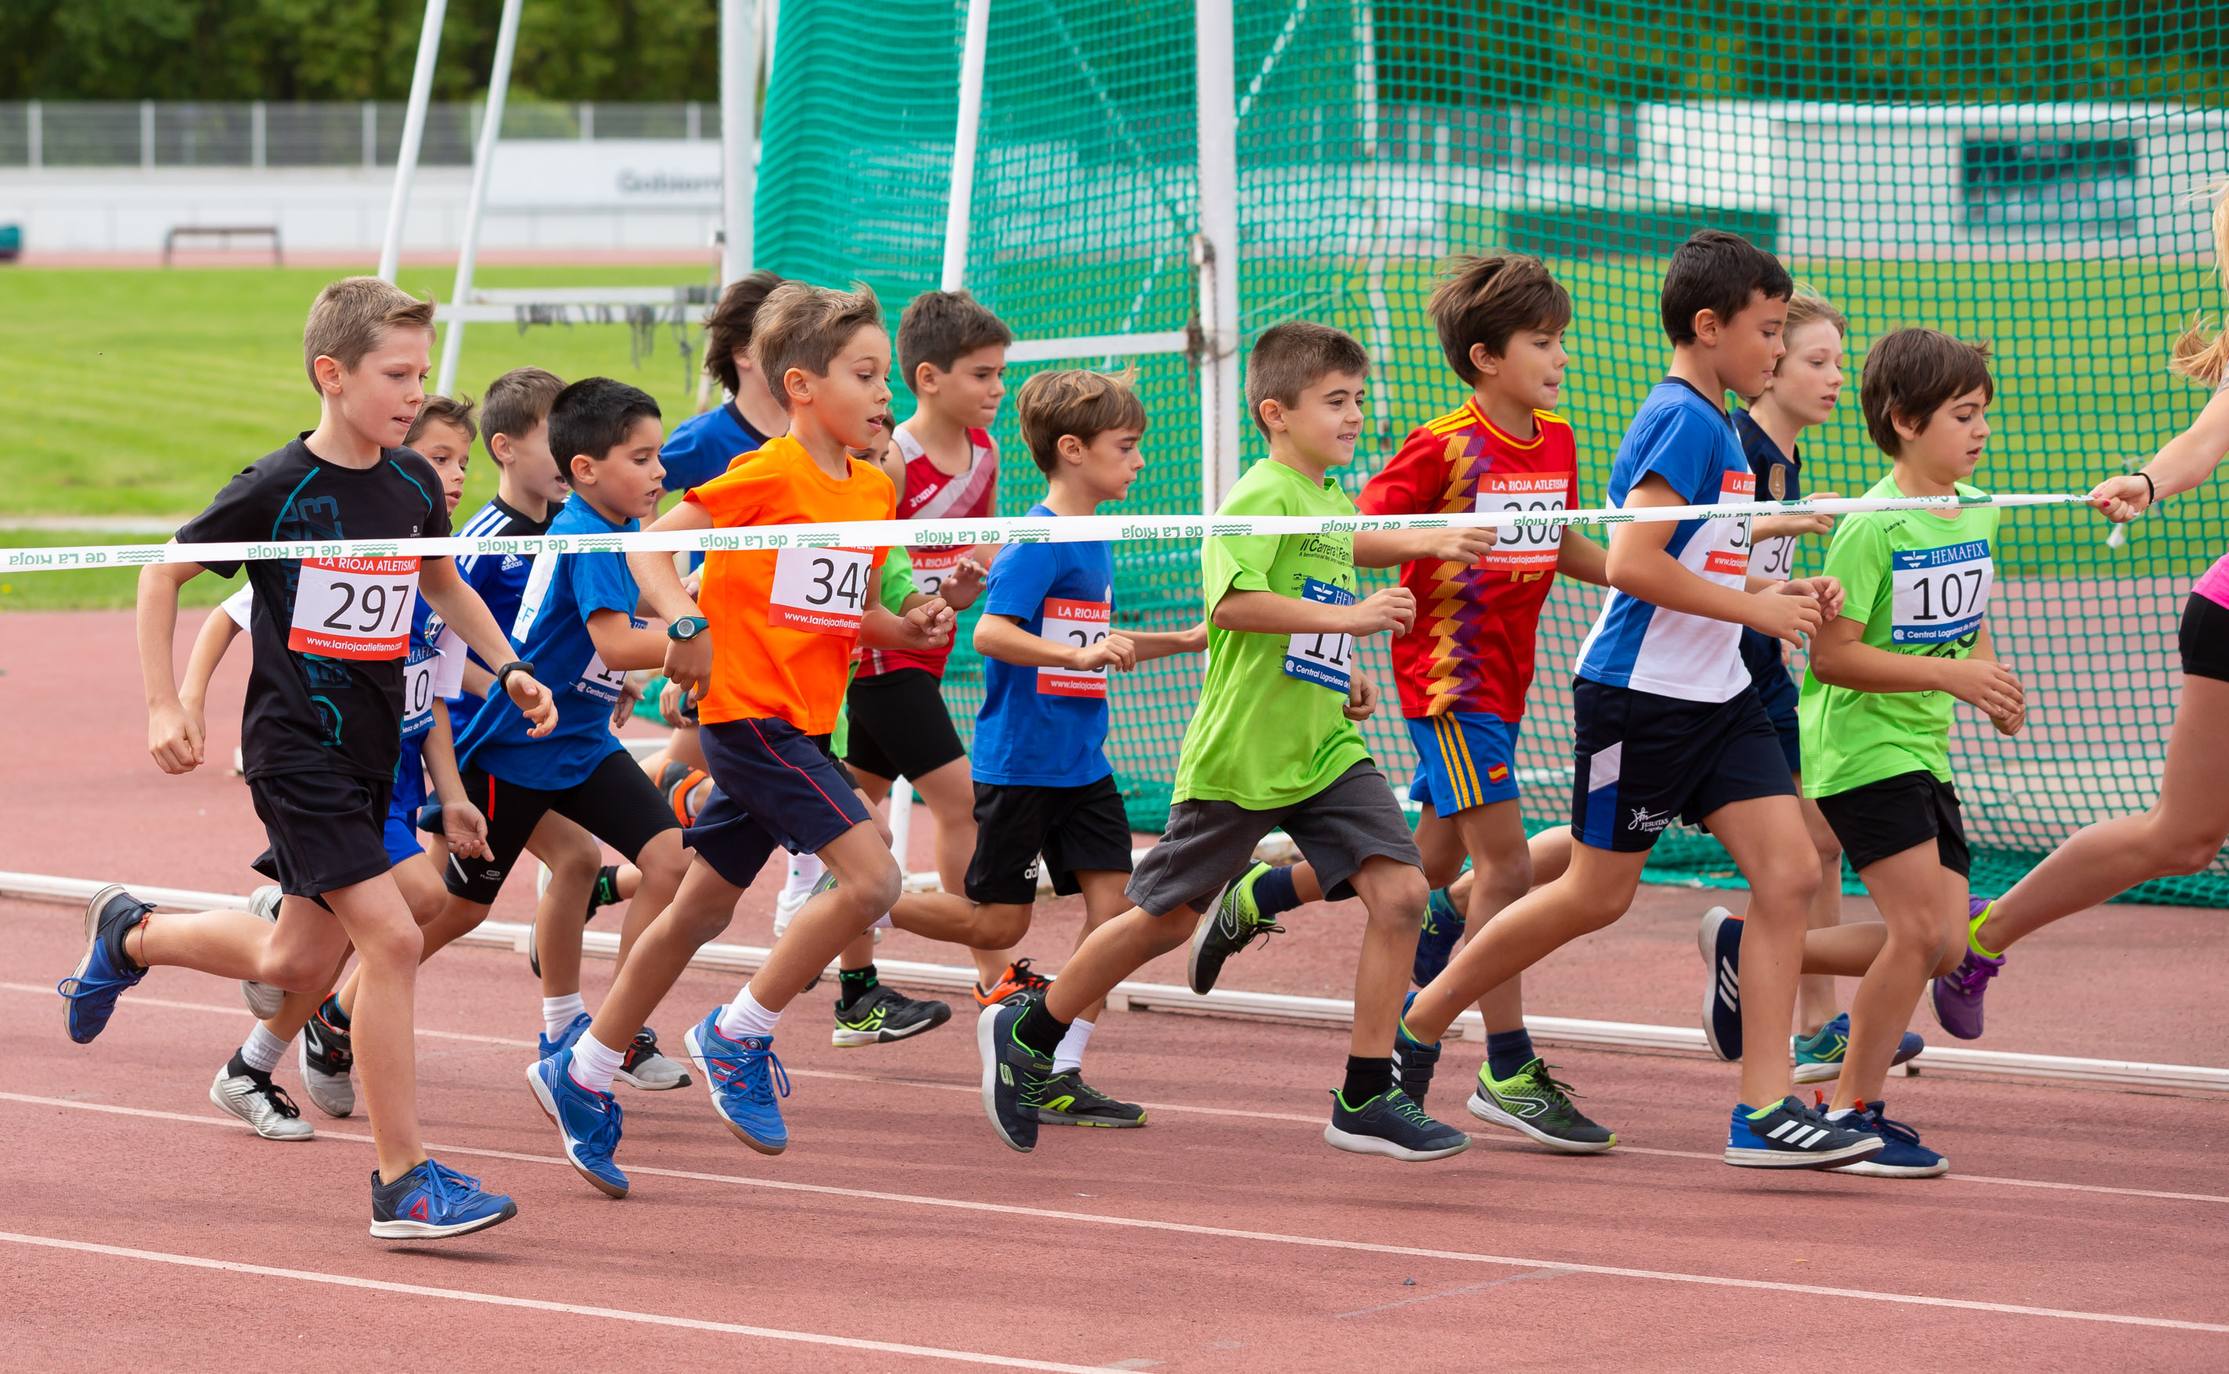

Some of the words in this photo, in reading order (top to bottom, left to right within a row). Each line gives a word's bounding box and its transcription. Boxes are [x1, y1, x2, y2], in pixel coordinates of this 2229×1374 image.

[1492, 480, 1505, 490] LA
[1509, 480, 1532, 490] RIOJA
[1732, 480, 1741, 490] LA
[915, 529, 953, 545] Rioja
[958, 530, 976, 543] La
[981, 530, 1000, 544] de
[1163, 525, 1180, 537] La
[477, 540, 518, 554] Rioja
[524, 540, 543, 554] La
[548, 539, 568, 553] de
[699, 534, 739, 550] Rioja
[745, 534, 763, 548] La
[768, 534, 788, 549] de
[59, 553, 79, 563] La
[247, 545, 288, 559] Rioja
[296, 545, 314, 558] La
[321, 545, 342, 557] de
[1931, 542, 1985, 564] HEMAFIX
[318, 556, 334, 567] LA
[338, 558, 373, 571] RIOJA
[501, 560, 523, 572] adidas
[1912, 569, 1982, 620] 107
[323, 582, 409, 632] 297
[1058, 606, 1071, 617] LA
[1074, 607, 1099, 619] RIOJA
[1907, 630, 1936, 639] Central
[1296, 665, 1320, 678] Central
